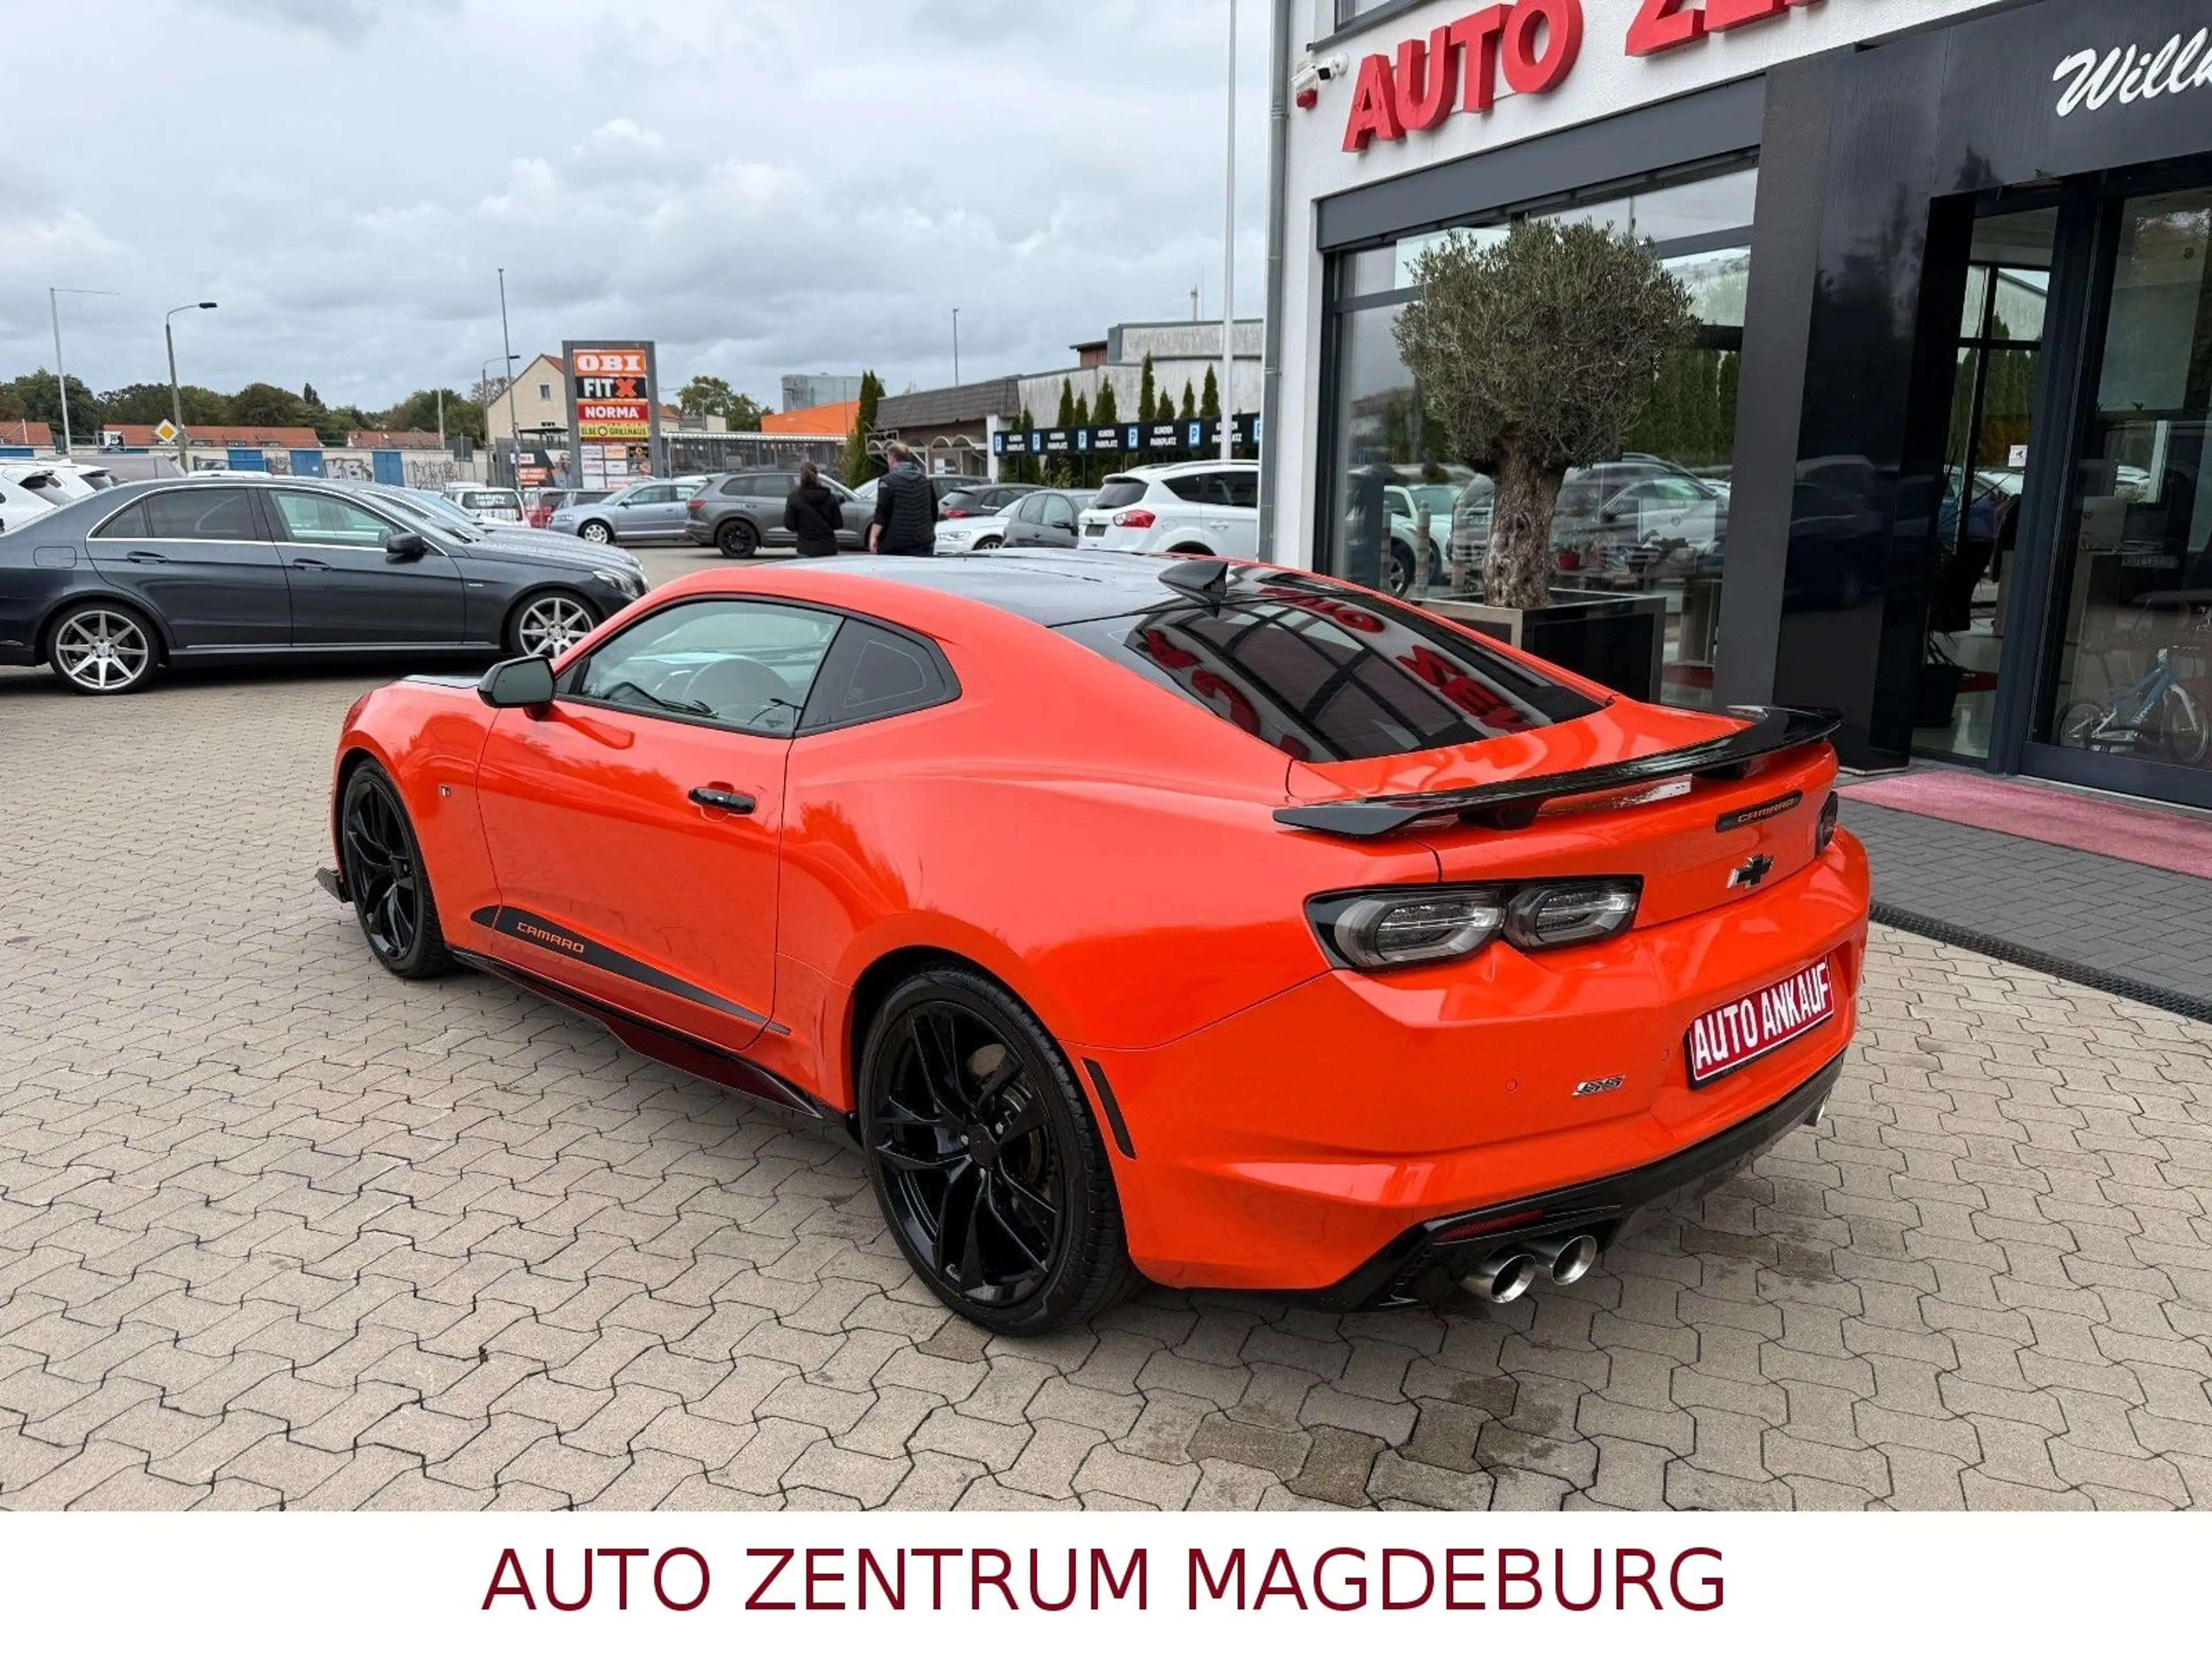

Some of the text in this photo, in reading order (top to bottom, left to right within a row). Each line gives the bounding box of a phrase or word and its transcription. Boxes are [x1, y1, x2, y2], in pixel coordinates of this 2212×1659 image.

[1342, 0, 1583, 152] AUTO
[577, 355, 641, 372] OBI
[585, 406, 639, 419] NORMA
[1738, 797, 1798, 823] CAMARO
[517, 922, 585, 953] CAMARO
[1694, 962, 1828, 1070] AUTO ANKAUF
